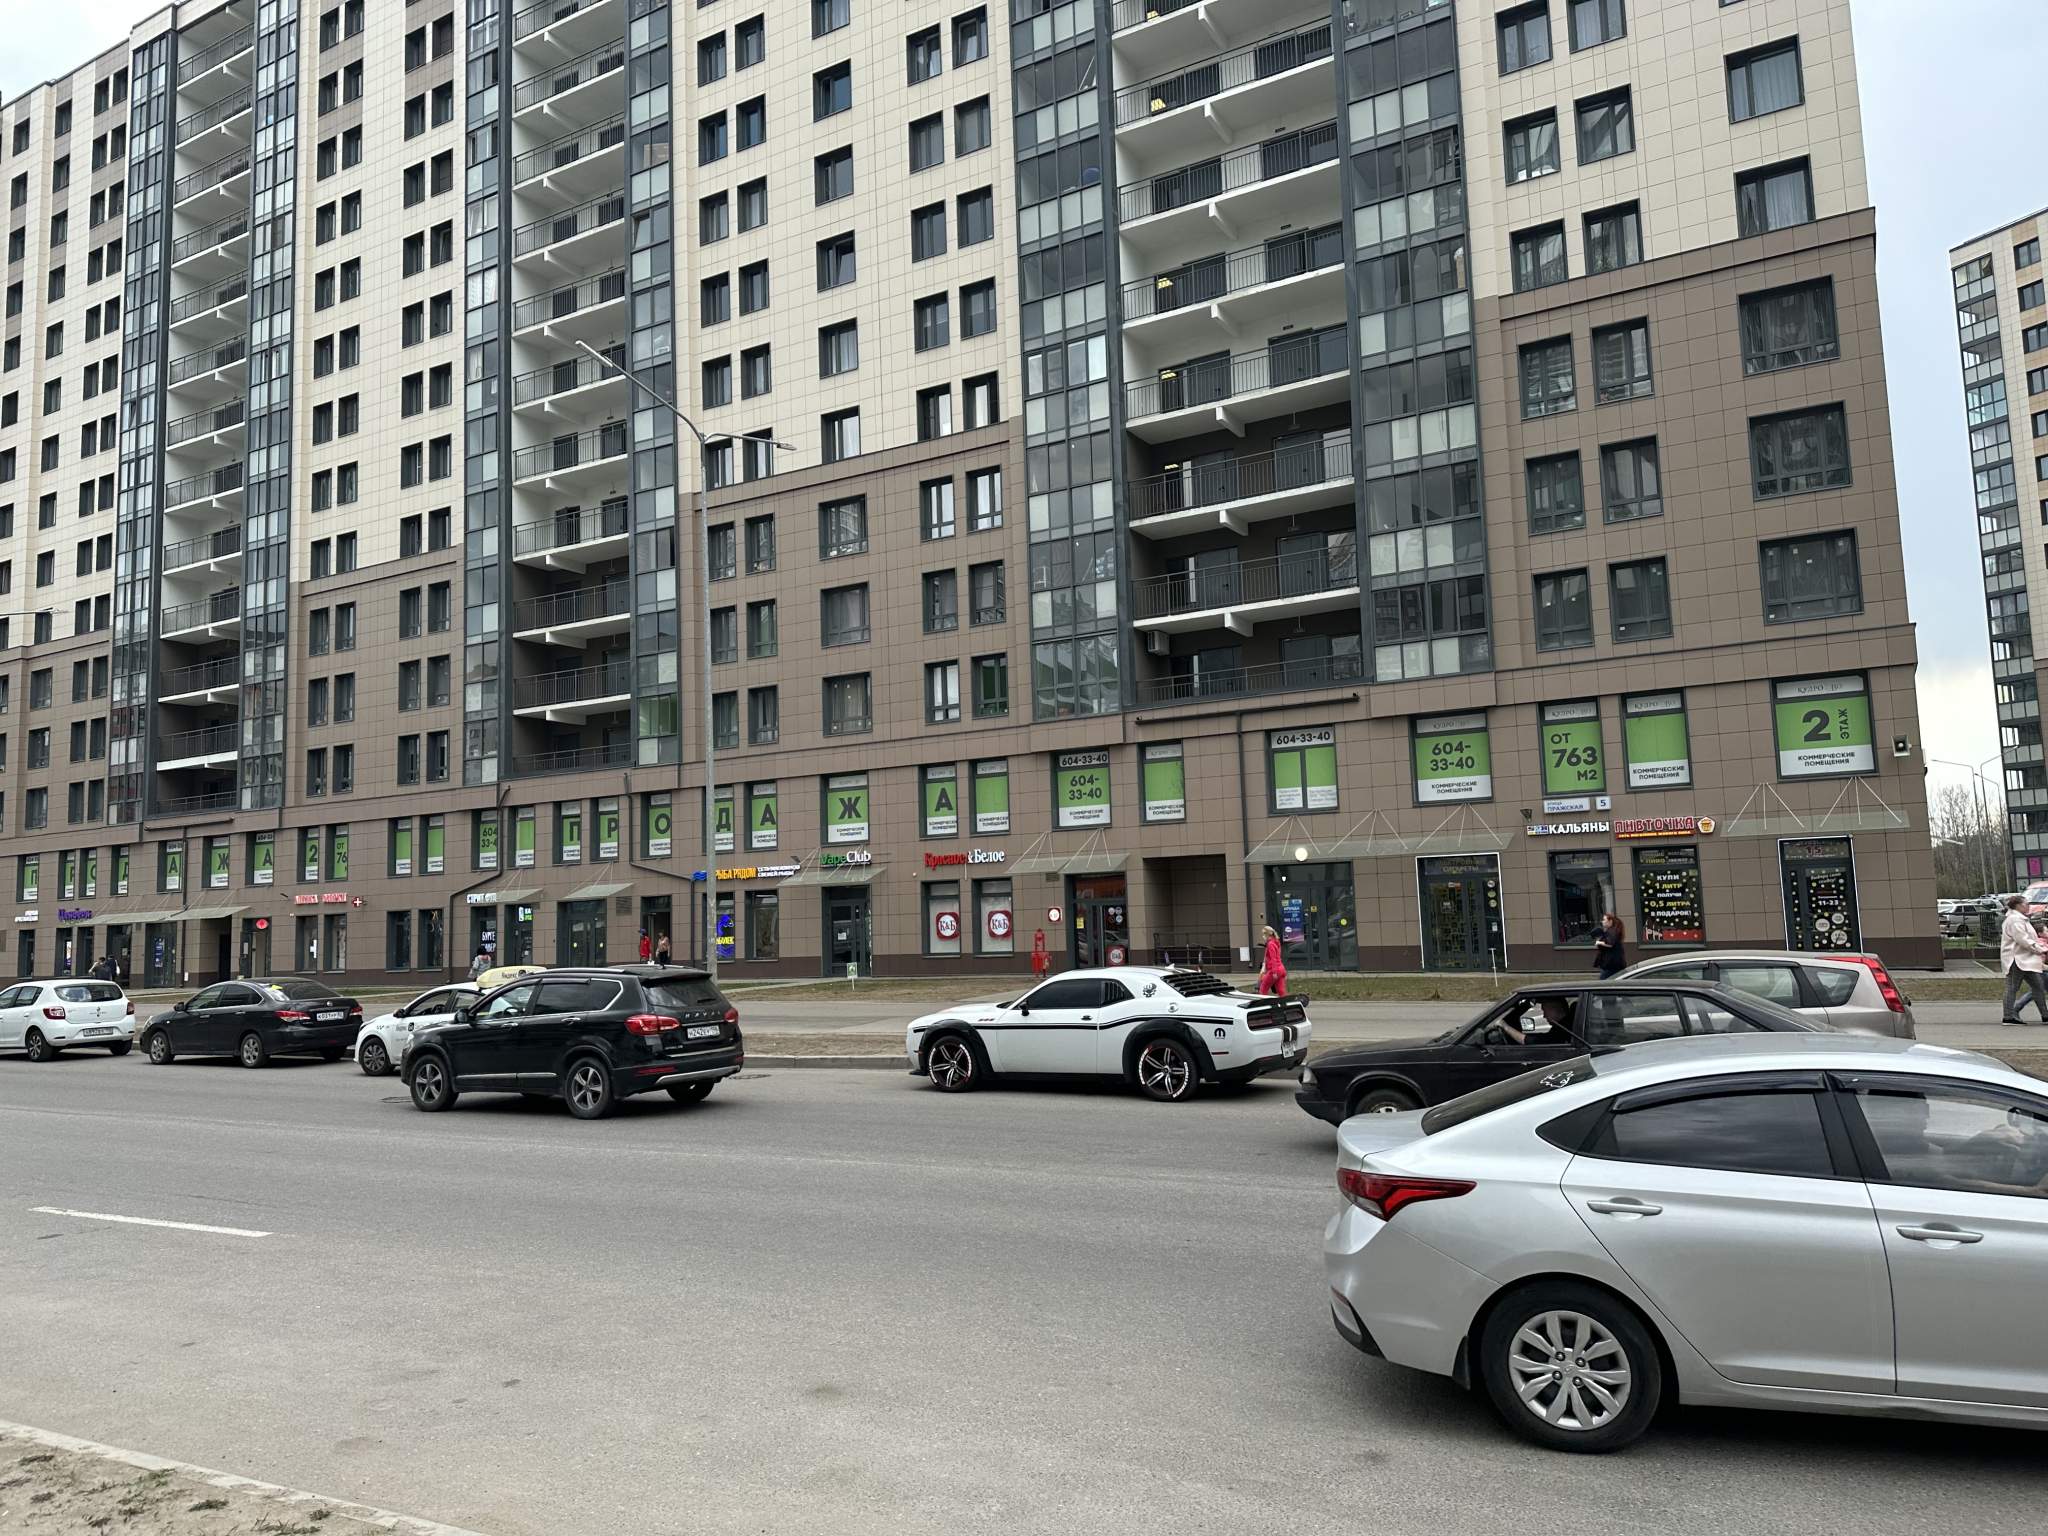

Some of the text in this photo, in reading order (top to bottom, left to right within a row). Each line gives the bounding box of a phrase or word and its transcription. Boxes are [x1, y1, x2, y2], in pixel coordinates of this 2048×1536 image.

[1802, 709, 1832, 743] 2
[1838, 708, 1850, 740] ЭТАЖ
[1276, 731, 1331, 745] 604-33-40
[1550, 733, 1572, 745] ОТ
[1431, 740, 1472, 756] 604-
[1797, 751, 1856, 761] КОММЕРЧЕСКИЕ
[1061, 753, 1108, 766] 604-33-40
[1430, 756, 1475, 772] 33-40
[1552, 746, 1599, 769] 763
[1804, 758, 1850, 767] ПОМЕЩЕНИЯ
[1577, 769, 1598, 782] М2
[1632, 764, 1686, 775] КОММЕРЧЕСКИЕ
[1638, 772, 1680, 781] ПОМЕЩЕНИЯ
[1431, 781, 1478, 789] КОММЕРЧЕСКИЕ
[934, 786, 954, 812] А
[1068, 788, 1102, 801] 33-40
[838, 795, 862, 820] Ж
[1600, 799, 1607, 807] 5
[716, 807, 731, 832] Д
[760, 803, 776, 826] А
[607, 817, 618, 838] Р
[655, 813, 671, 835] О
[1549, 821, 1610, 835] КАЛЬЯНЫ
[1614, 816, 1695, 833] ПИВТОЧКА
[262, 848, 272, 866] А
[308, 844, 318, 863] 2
[168, 855, 178, 874] А
